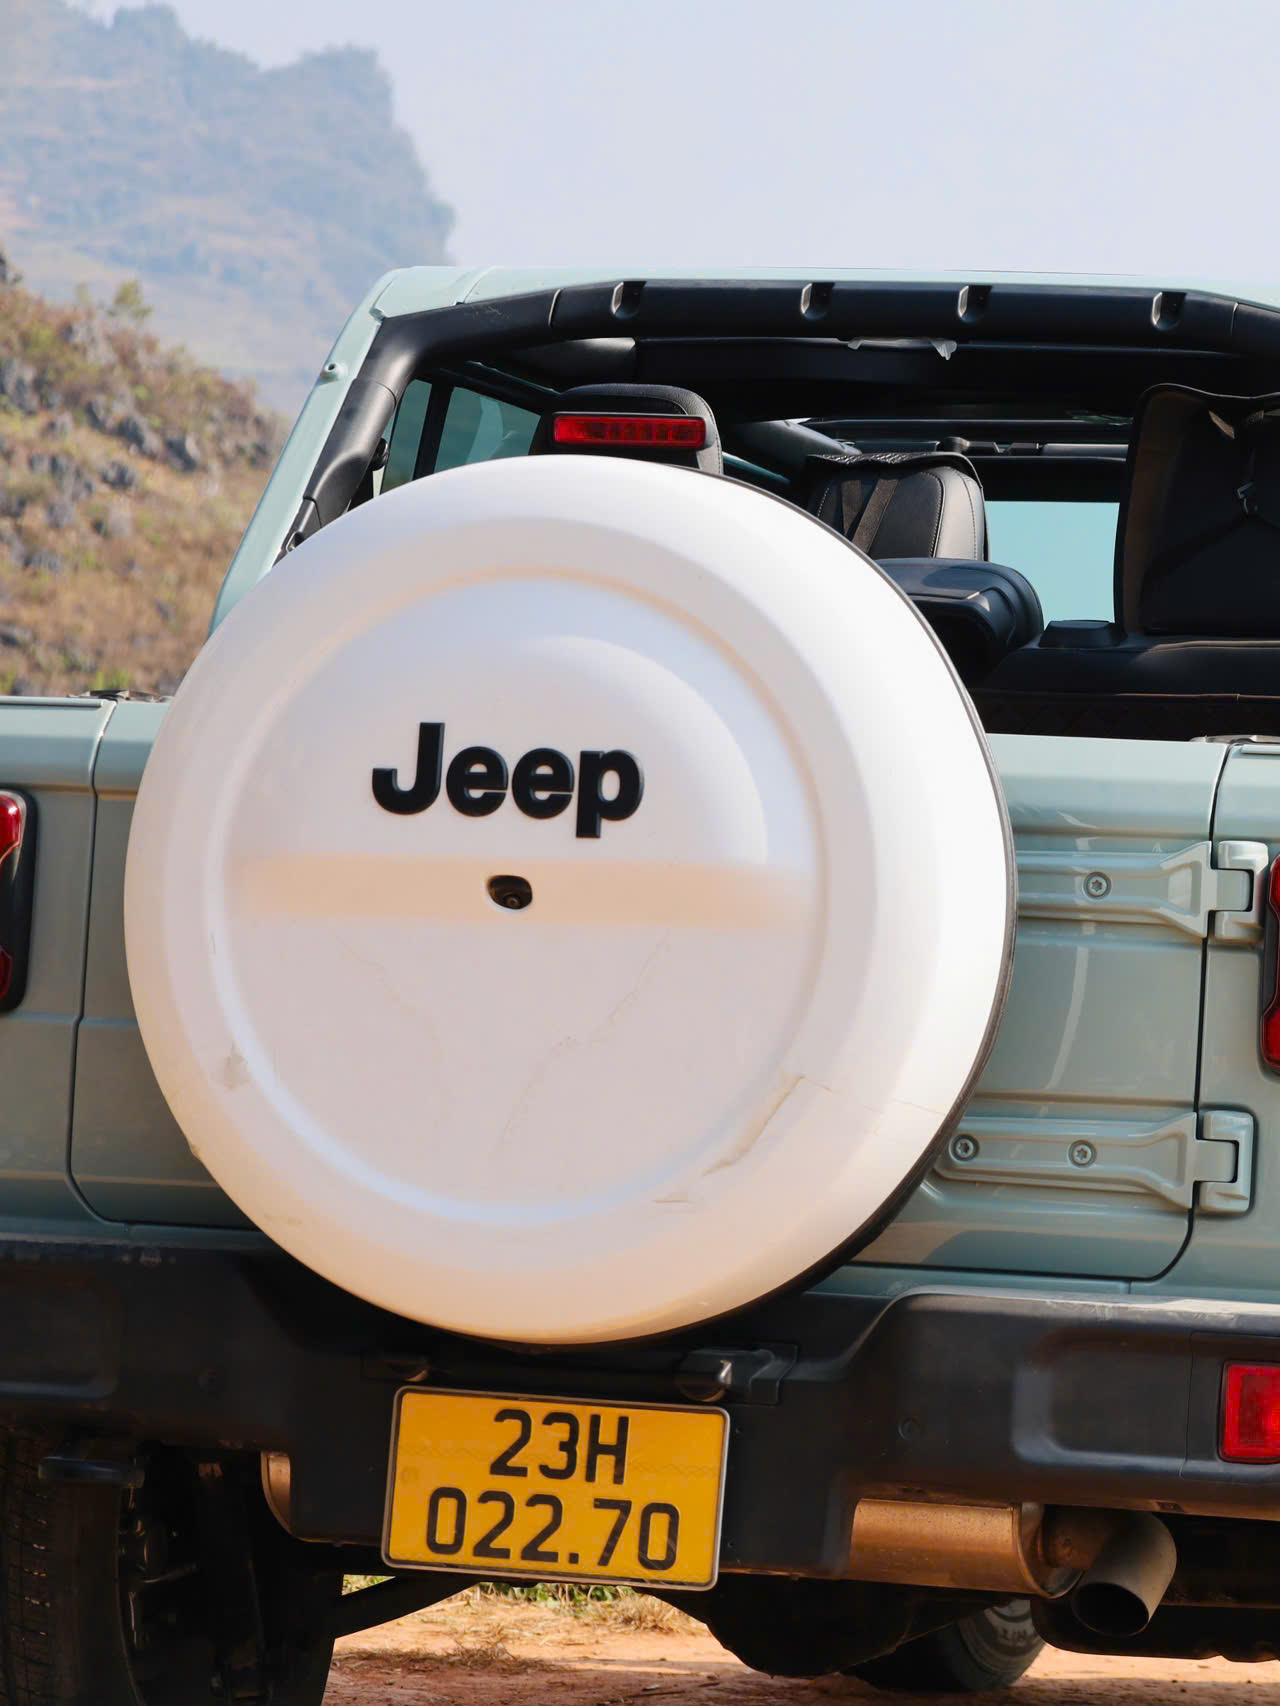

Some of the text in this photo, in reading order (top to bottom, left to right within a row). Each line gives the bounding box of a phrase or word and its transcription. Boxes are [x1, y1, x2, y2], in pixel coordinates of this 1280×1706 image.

[372, 721, 645, 839] Jeep
[489, 1408, 630, 1485] 23H
[426, 1486, 680, 1571] 022.70
